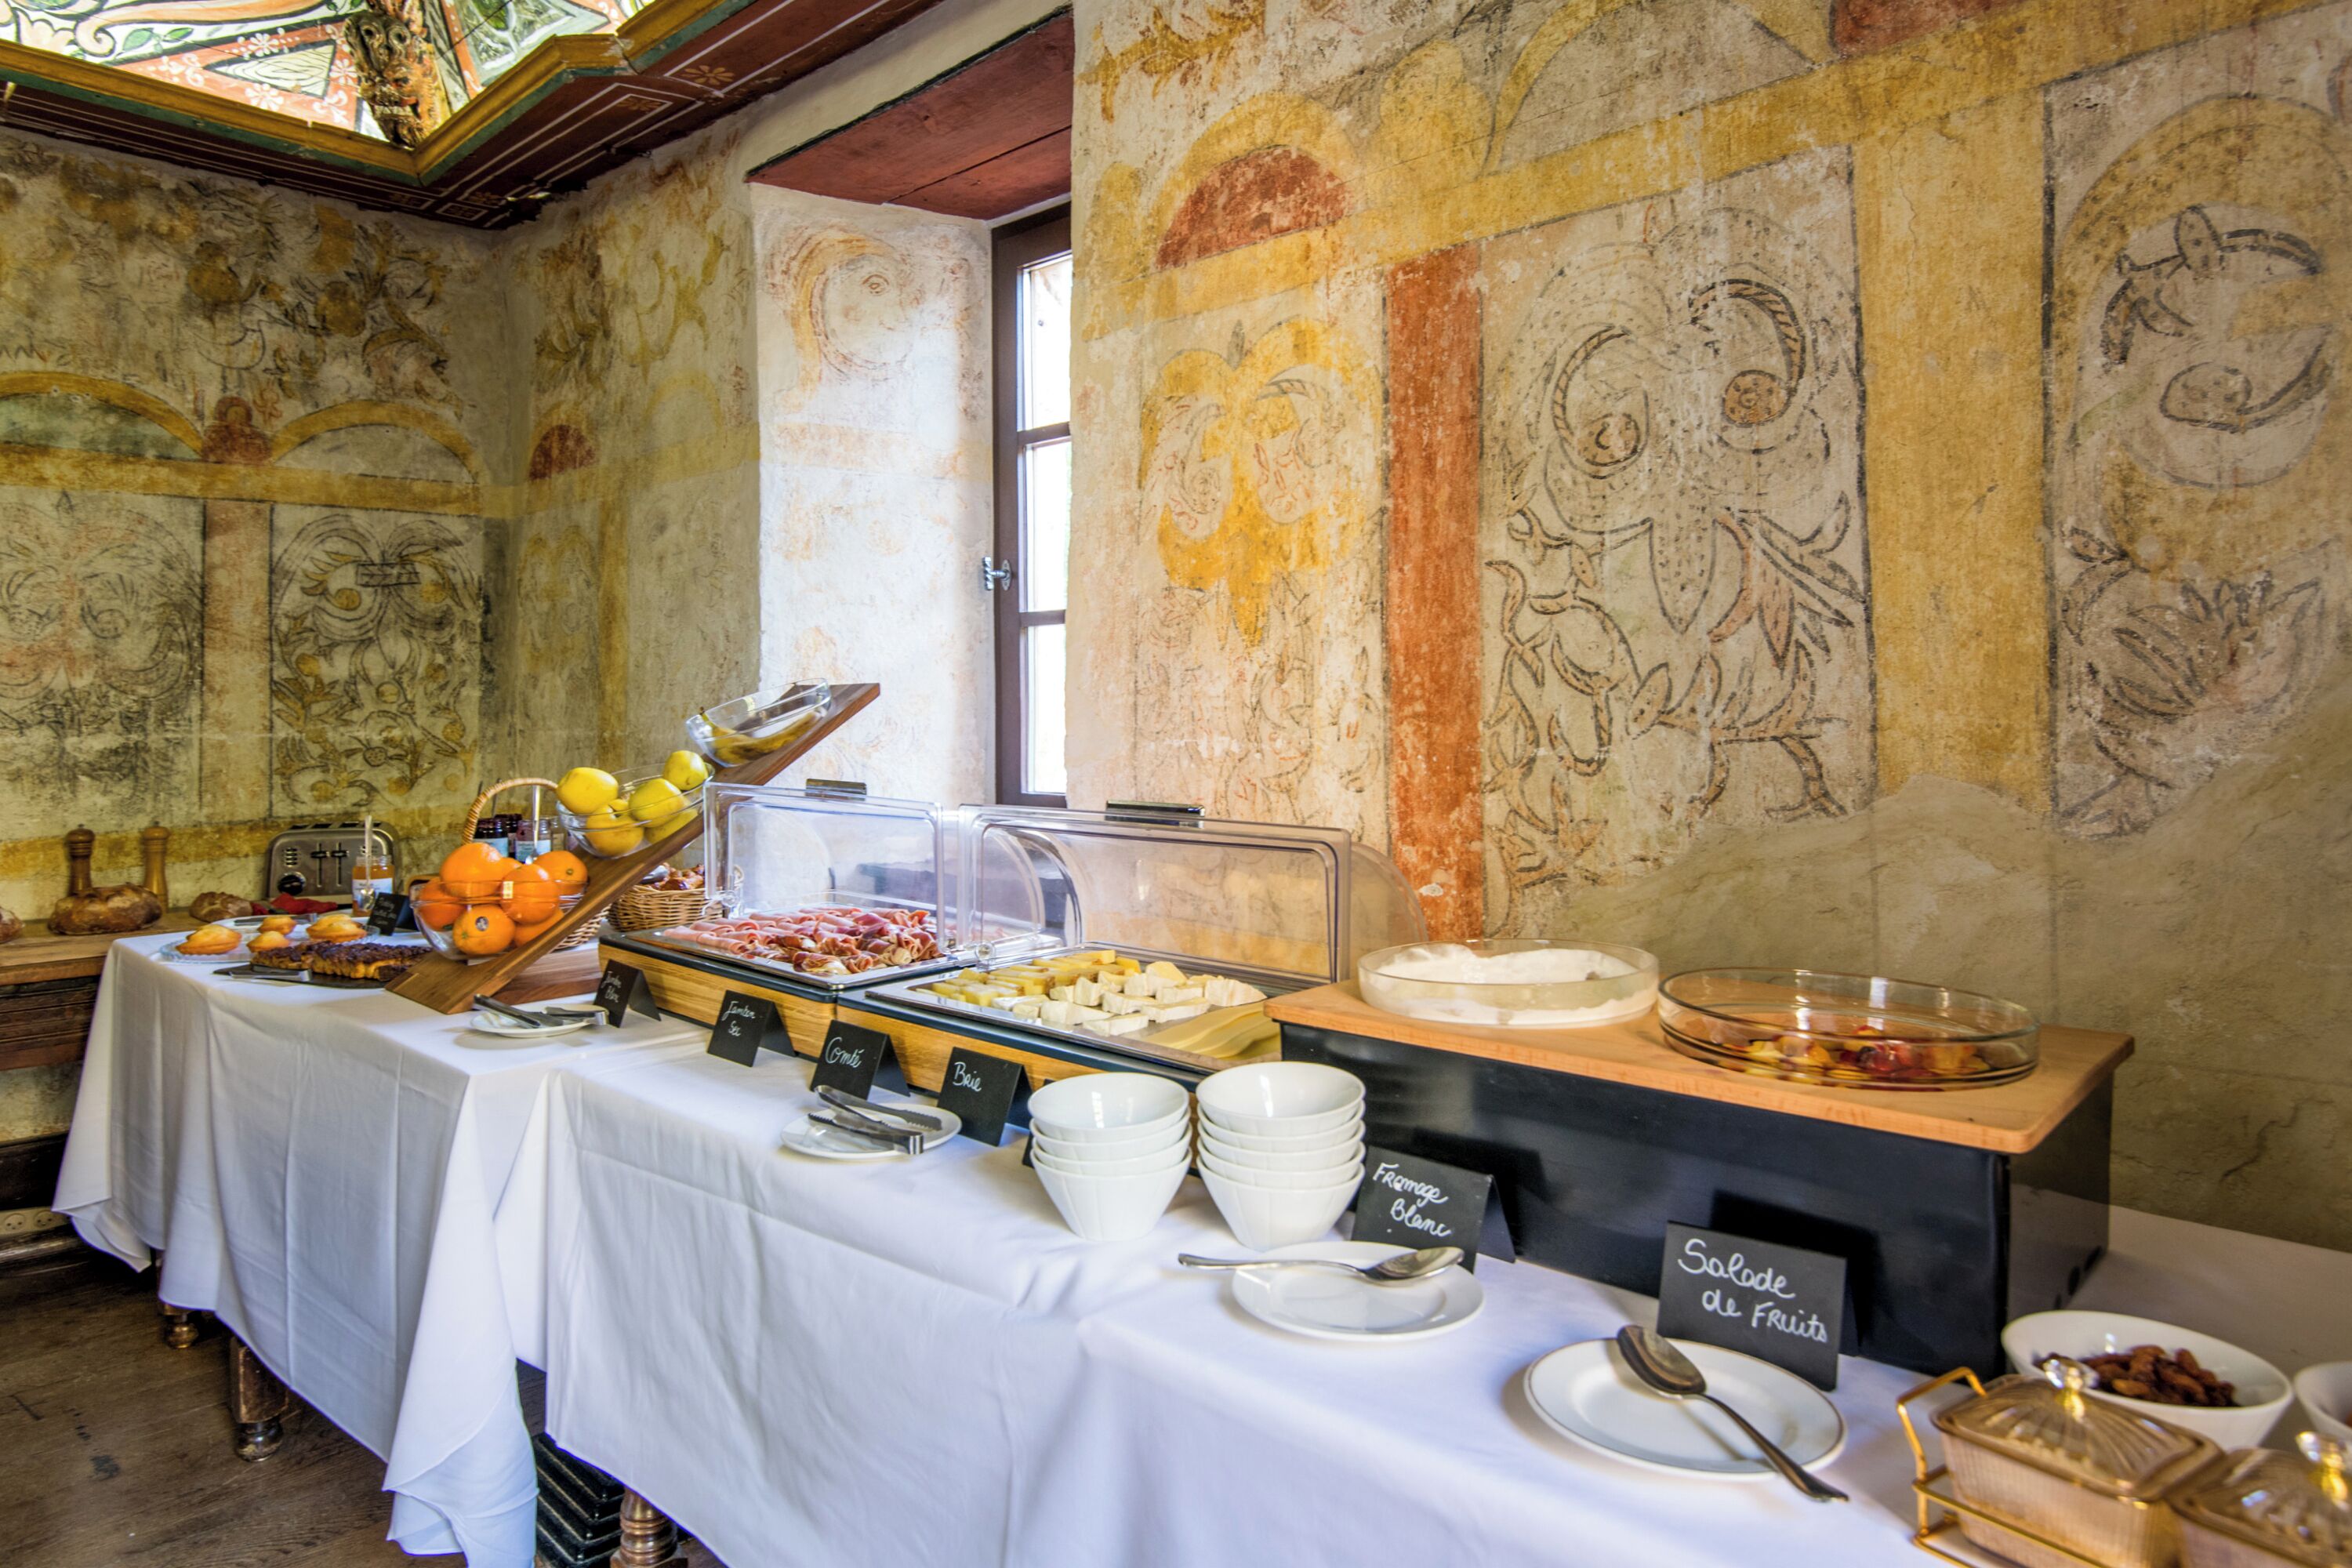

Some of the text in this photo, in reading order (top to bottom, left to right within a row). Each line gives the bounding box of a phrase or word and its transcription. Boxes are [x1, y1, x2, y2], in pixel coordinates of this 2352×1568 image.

[825, 1036, 865, 1068] Comté
[952, 1061, 982, 1092] Brie
[1390, 1198, 1452, 1237] Blanc
[1677, 1238, 1796, 1298] Salade
[1701, 1290, 1742, 1316] de
